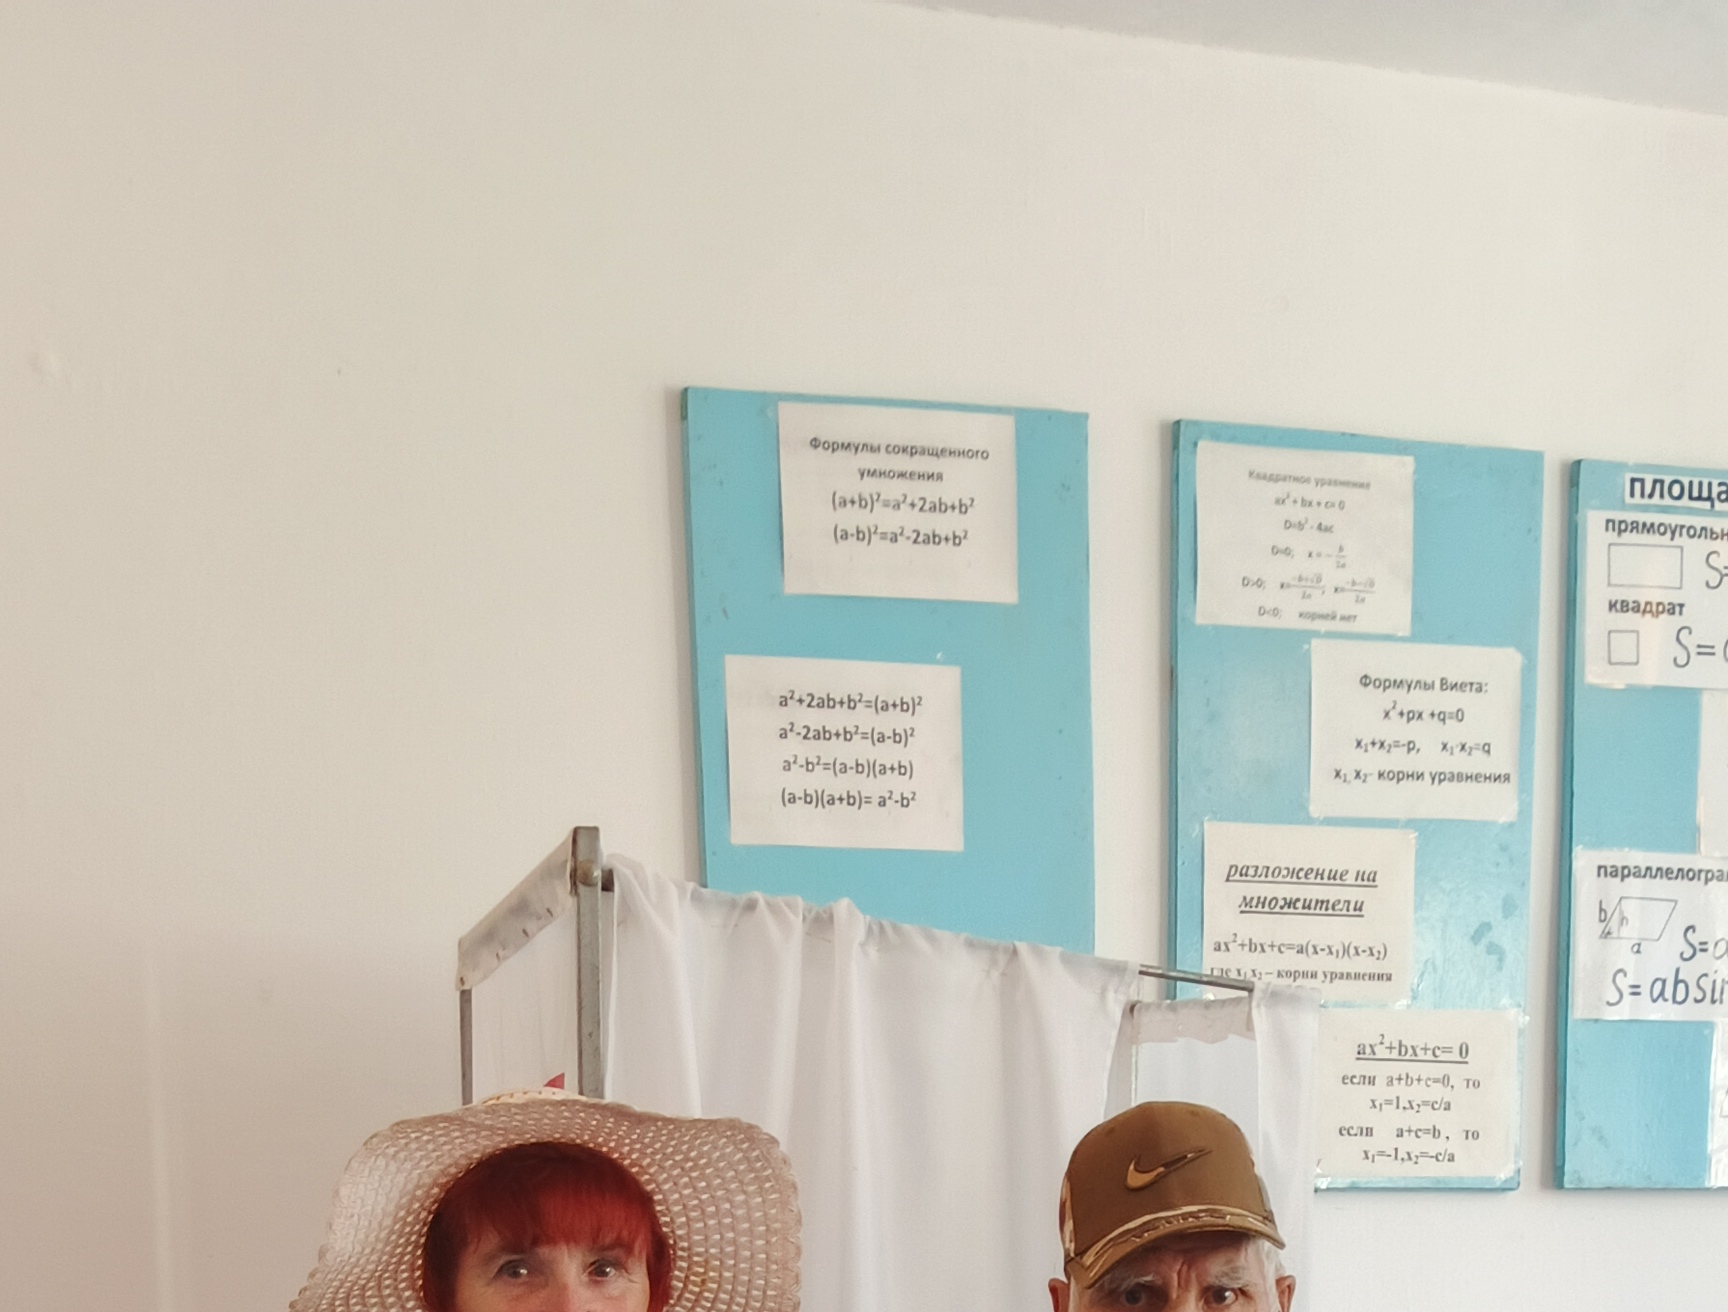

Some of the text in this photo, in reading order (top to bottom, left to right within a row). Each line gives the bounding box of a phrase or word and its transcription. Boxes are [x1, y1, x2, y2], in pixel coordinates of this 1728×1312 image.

[810, 437, 990, 461] Формулы сокращенного
[857, 467, 944, 483] умножения
[1629, 477, 1728, 508] площа
[1608, 598, 1685, 618] квадрат
[1359, 674, 1488, 694] Формулы Виета:
[1377, 770, 1425, 785] корни
[1429, 770, 1511, 786] уравнения
[1226, 862, 1377, 883] разложение на
[1596, 865, 1728, 886] параллелогра
[1238, 894, 1365, 914] множители
[1277, 970, 1318, 982] корни
[1321, 971, 1393, 984] уравнения
[1341, 1074, 1376, 1086] если
[1464, 1078, 1480, 1089] то
[1338, 1125, 1374, 1137] если
[1463, 1129, 1480, 1140] то
